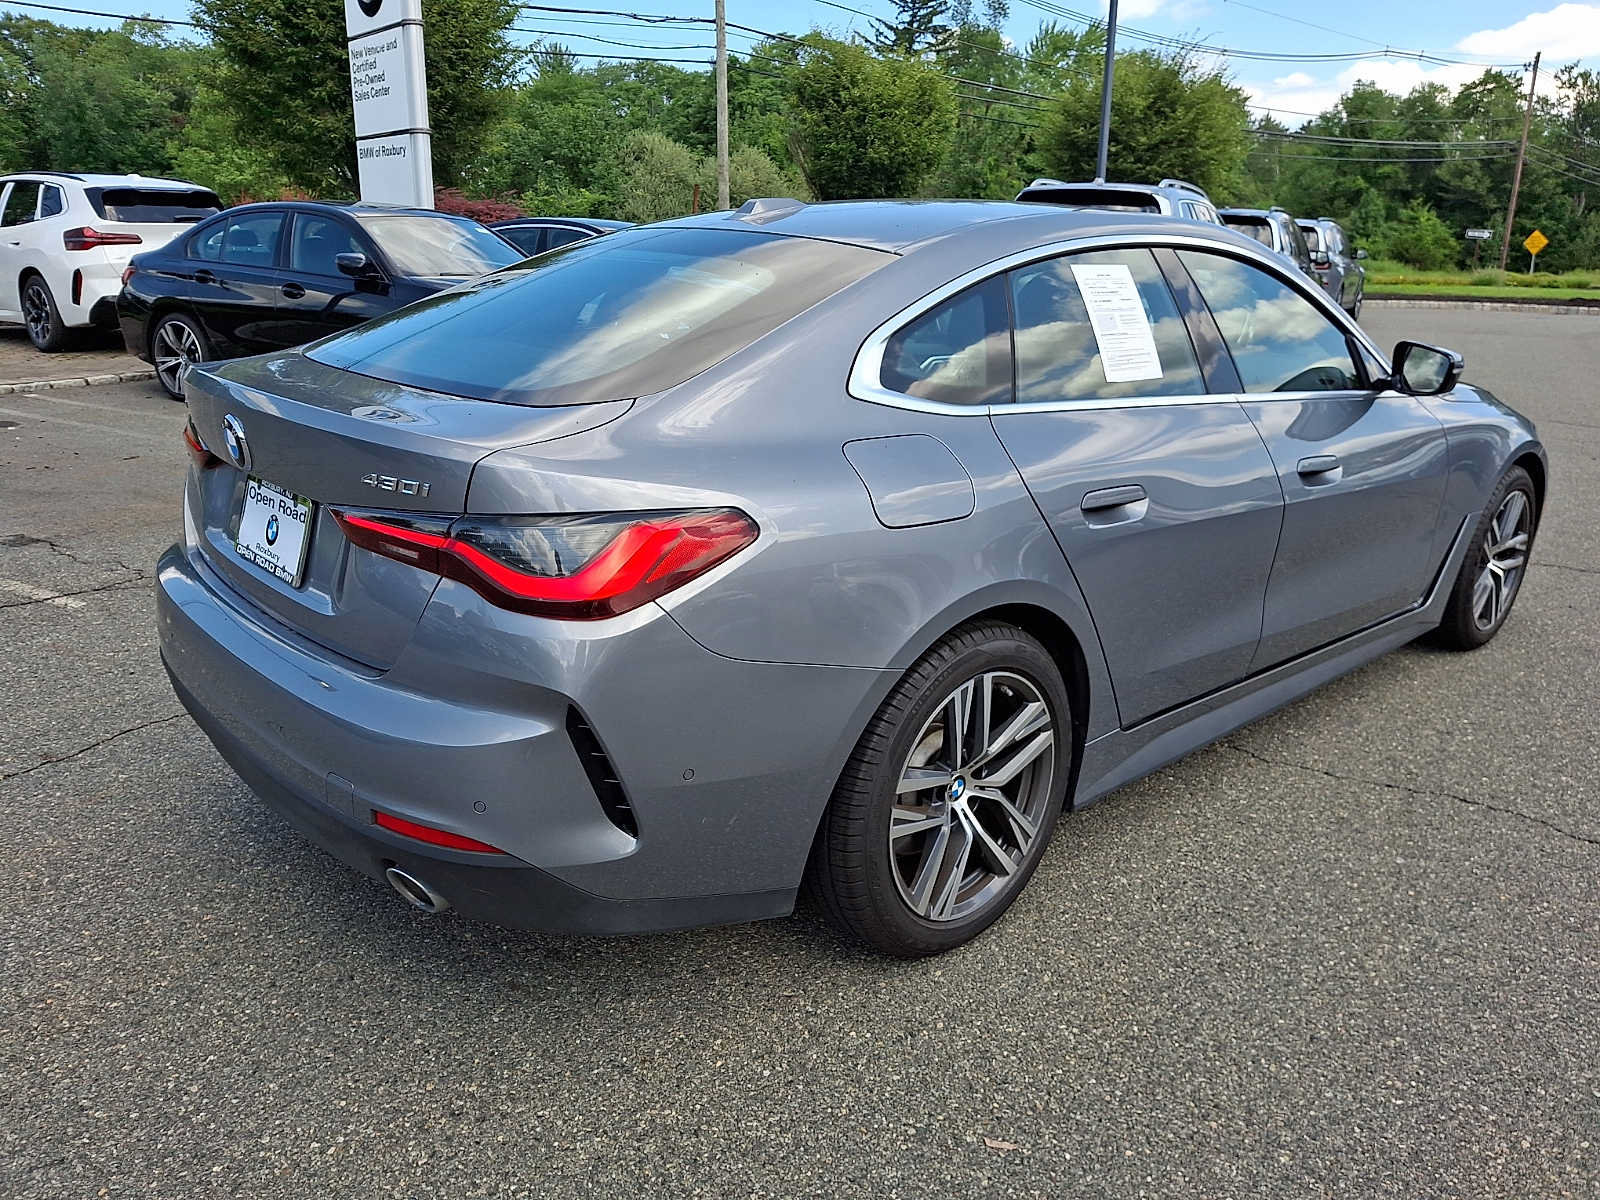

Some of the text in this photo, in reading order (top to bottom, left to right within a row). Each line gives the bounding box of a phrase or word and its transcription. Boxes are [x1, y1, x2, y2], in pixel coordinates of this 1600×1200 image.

[351, 48, 363, 60] New
[386, 37, 398, 51] and
[352, 57, 377, 74] Certified
[353, 69, 386, 88] Pre-Owned
[354, 86, 391, 102] Sales Center
[360, 144, 407, 159] BMW of Roxbury
[361, 473, 430, 497] 430i
[249, 486, 275, 509] Open
[278, 499, 308, 524] Road
[256, 542, 280, 563] Roxbury
[236, 544, 294, 584] OPEN ROAD BMW
